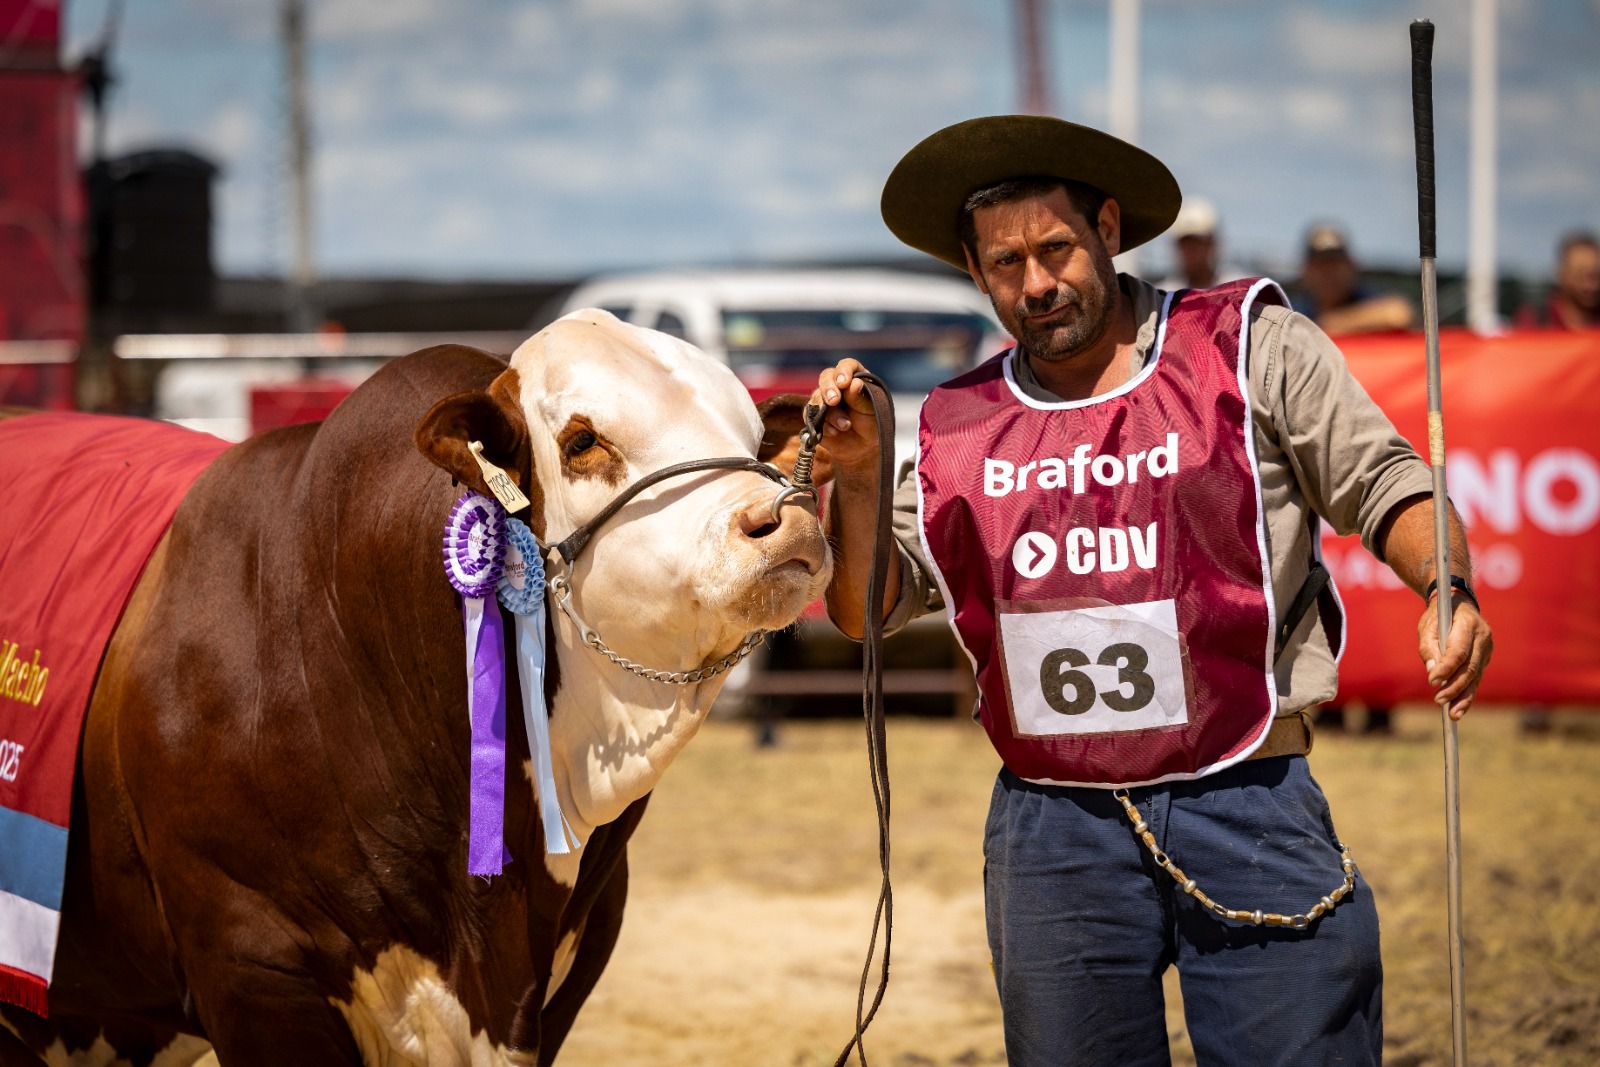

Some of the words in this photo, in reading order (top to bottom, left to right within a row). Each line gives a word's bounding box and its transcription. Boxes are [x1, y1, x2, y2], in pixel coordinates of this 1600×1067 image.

[984, 432, 1179, 497] Braford
[1065, 523, 1158, 575] CDV
[1041, 643, 1156, 715] 63
[0, 739, 24, 782] 025
